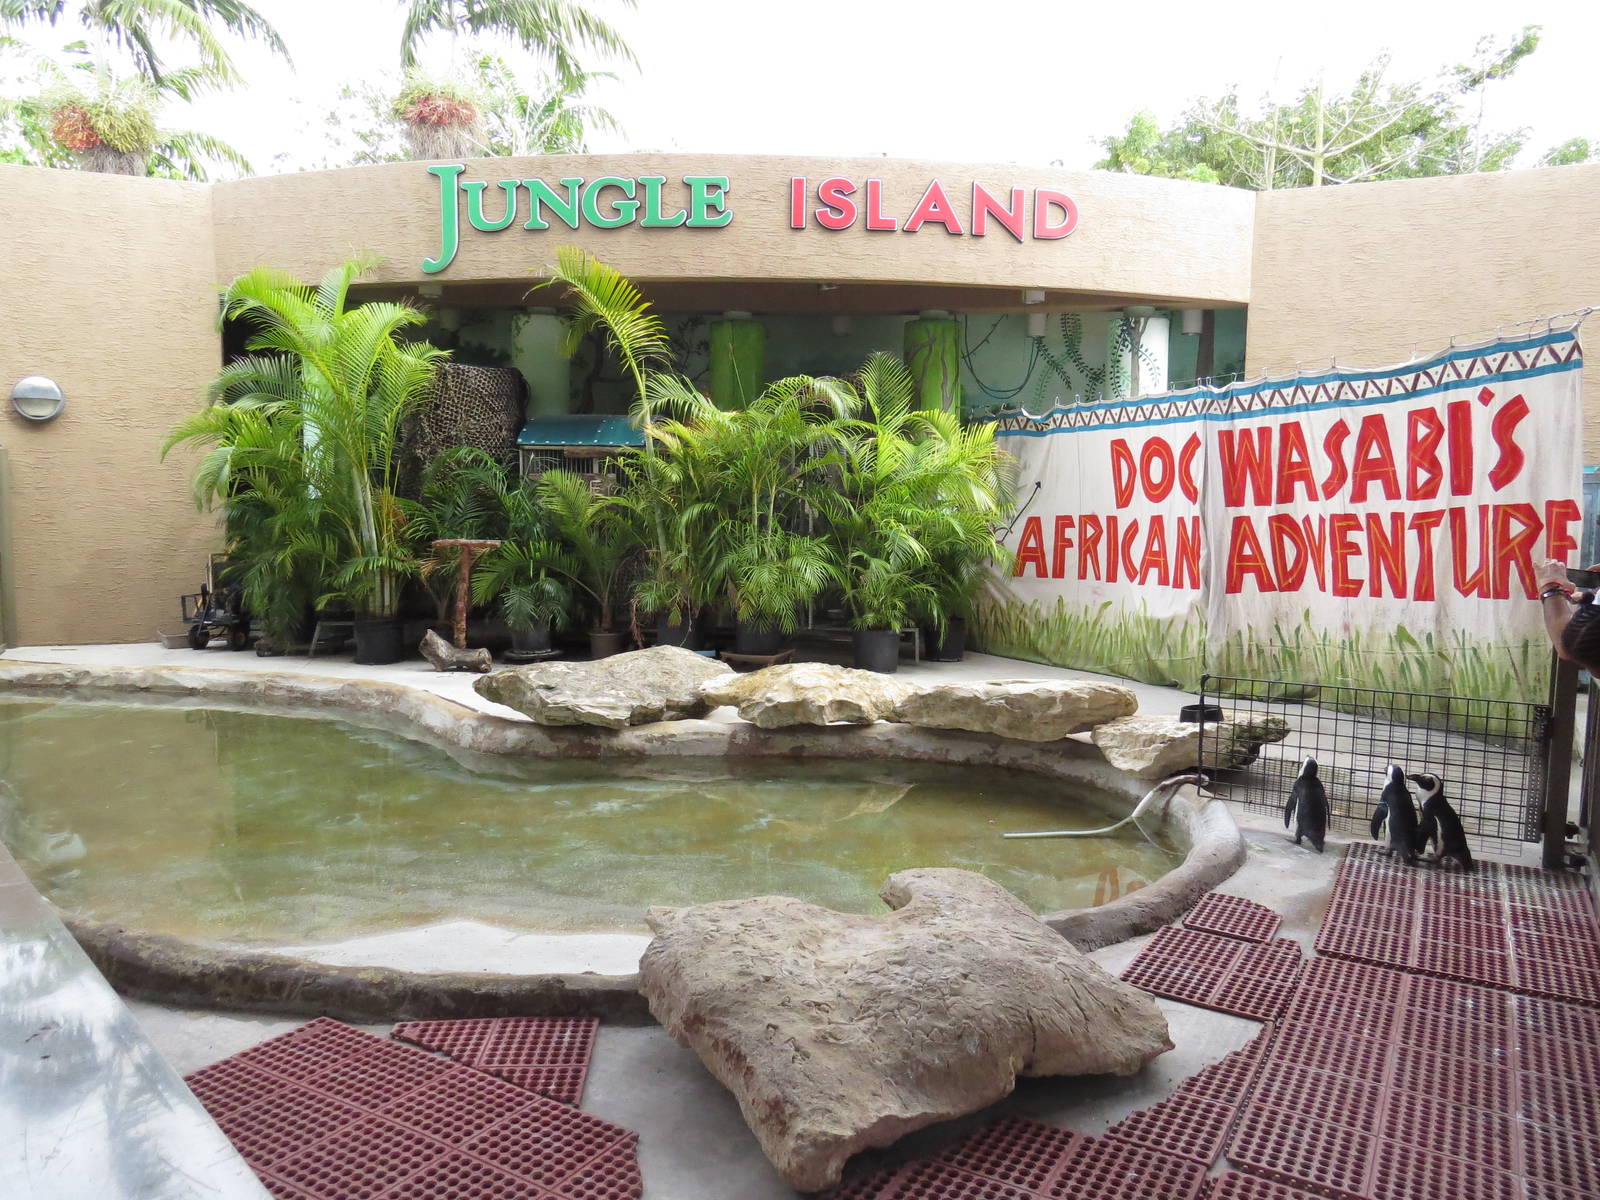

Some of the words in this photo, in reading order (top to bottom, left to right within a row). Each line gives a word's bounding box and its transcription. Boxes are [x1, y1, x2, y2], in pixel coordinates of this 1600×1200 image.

[421, 163, 733, 275] JUNGLE
[789, 175, 1080, 243] ISLAND
[1110, 431, 1202, 509] DOC
[1217, 386, 1530, 507] WASABI'S
[1014, 515, 1201, 590] AFRICAN
[1225, 499, 1582, 602] ADVENTURE
